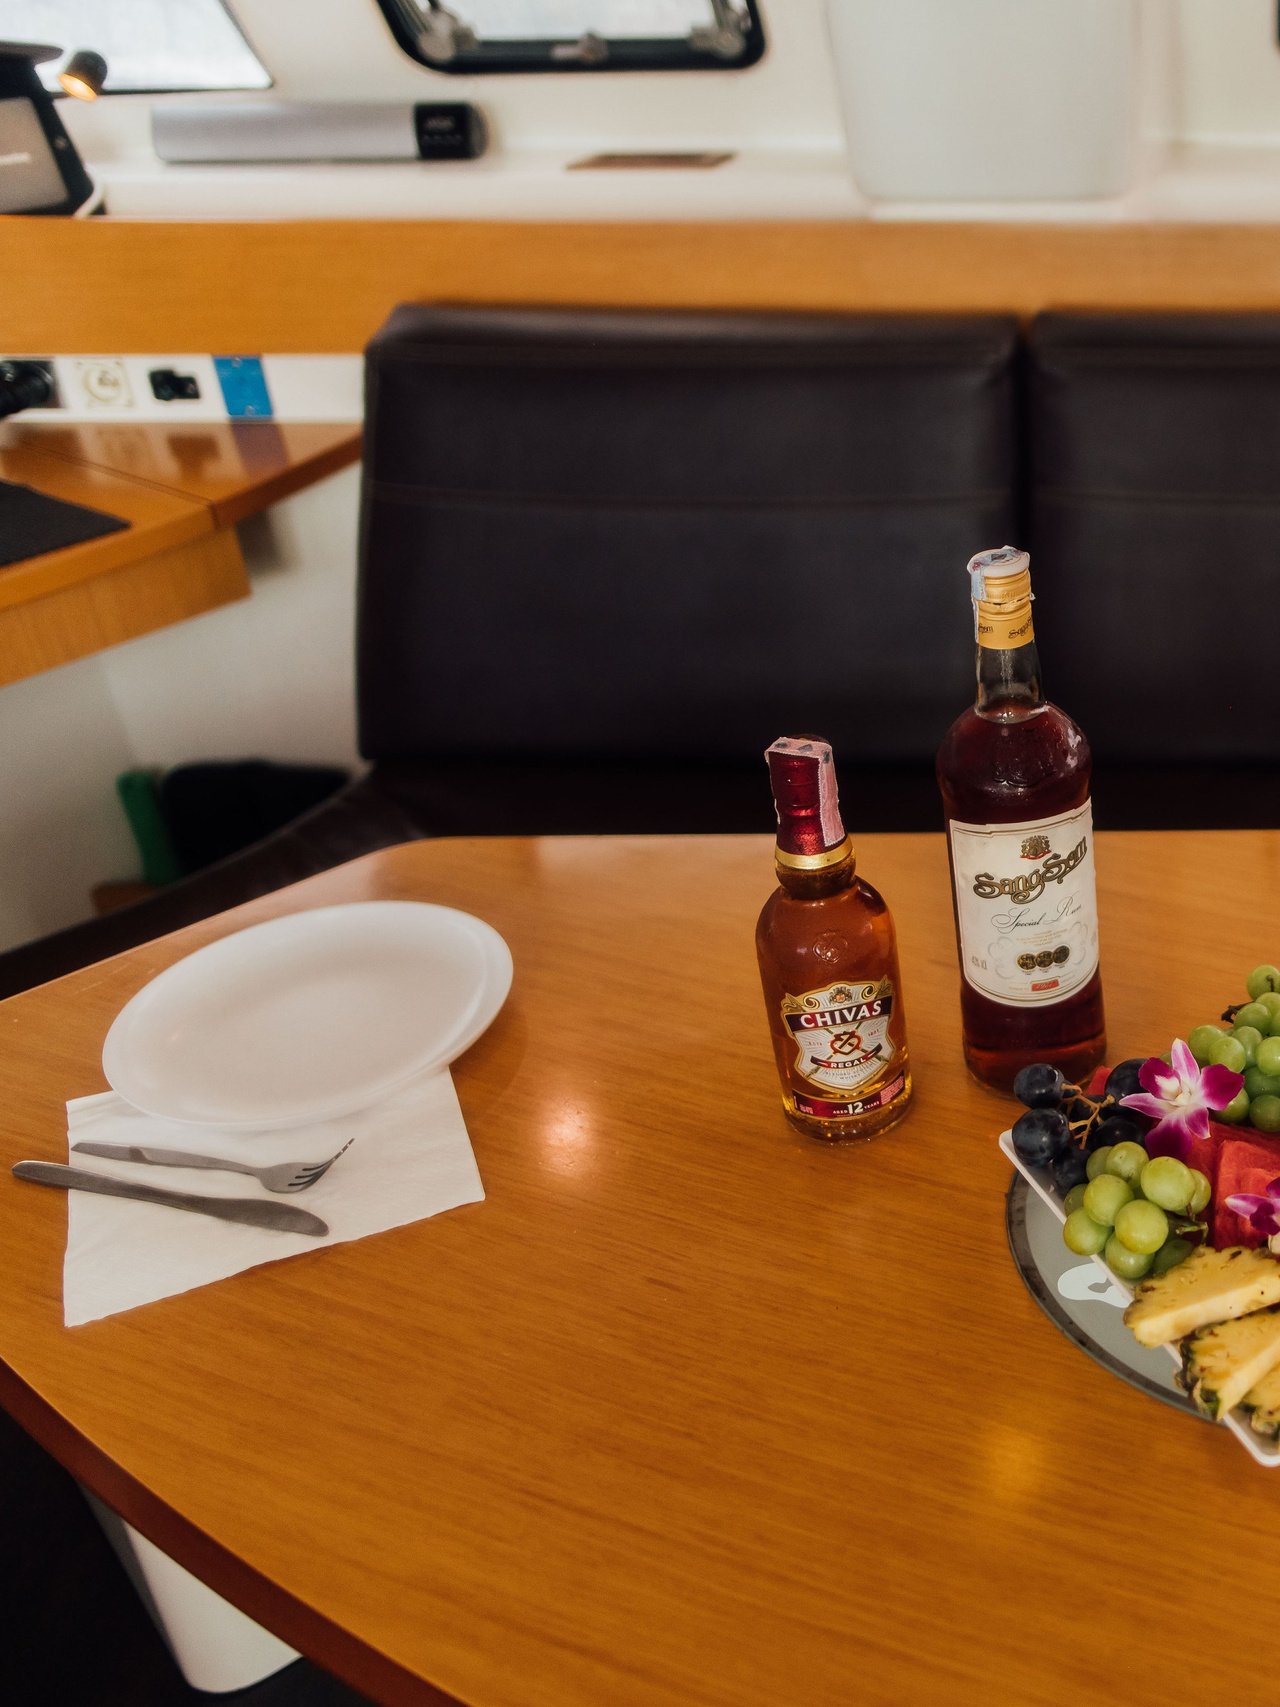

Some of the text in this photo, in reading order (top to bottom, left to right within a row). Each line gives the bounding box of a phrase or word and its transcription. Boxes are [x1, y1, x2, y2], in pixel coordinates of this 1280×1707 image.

[991, 907, 1047, 934] Special
[800, 1000, 882, 1028] CHIVAS
[830, 1057, 867, 1070] REGAL
[847, 1102, 864, 1115] 12
